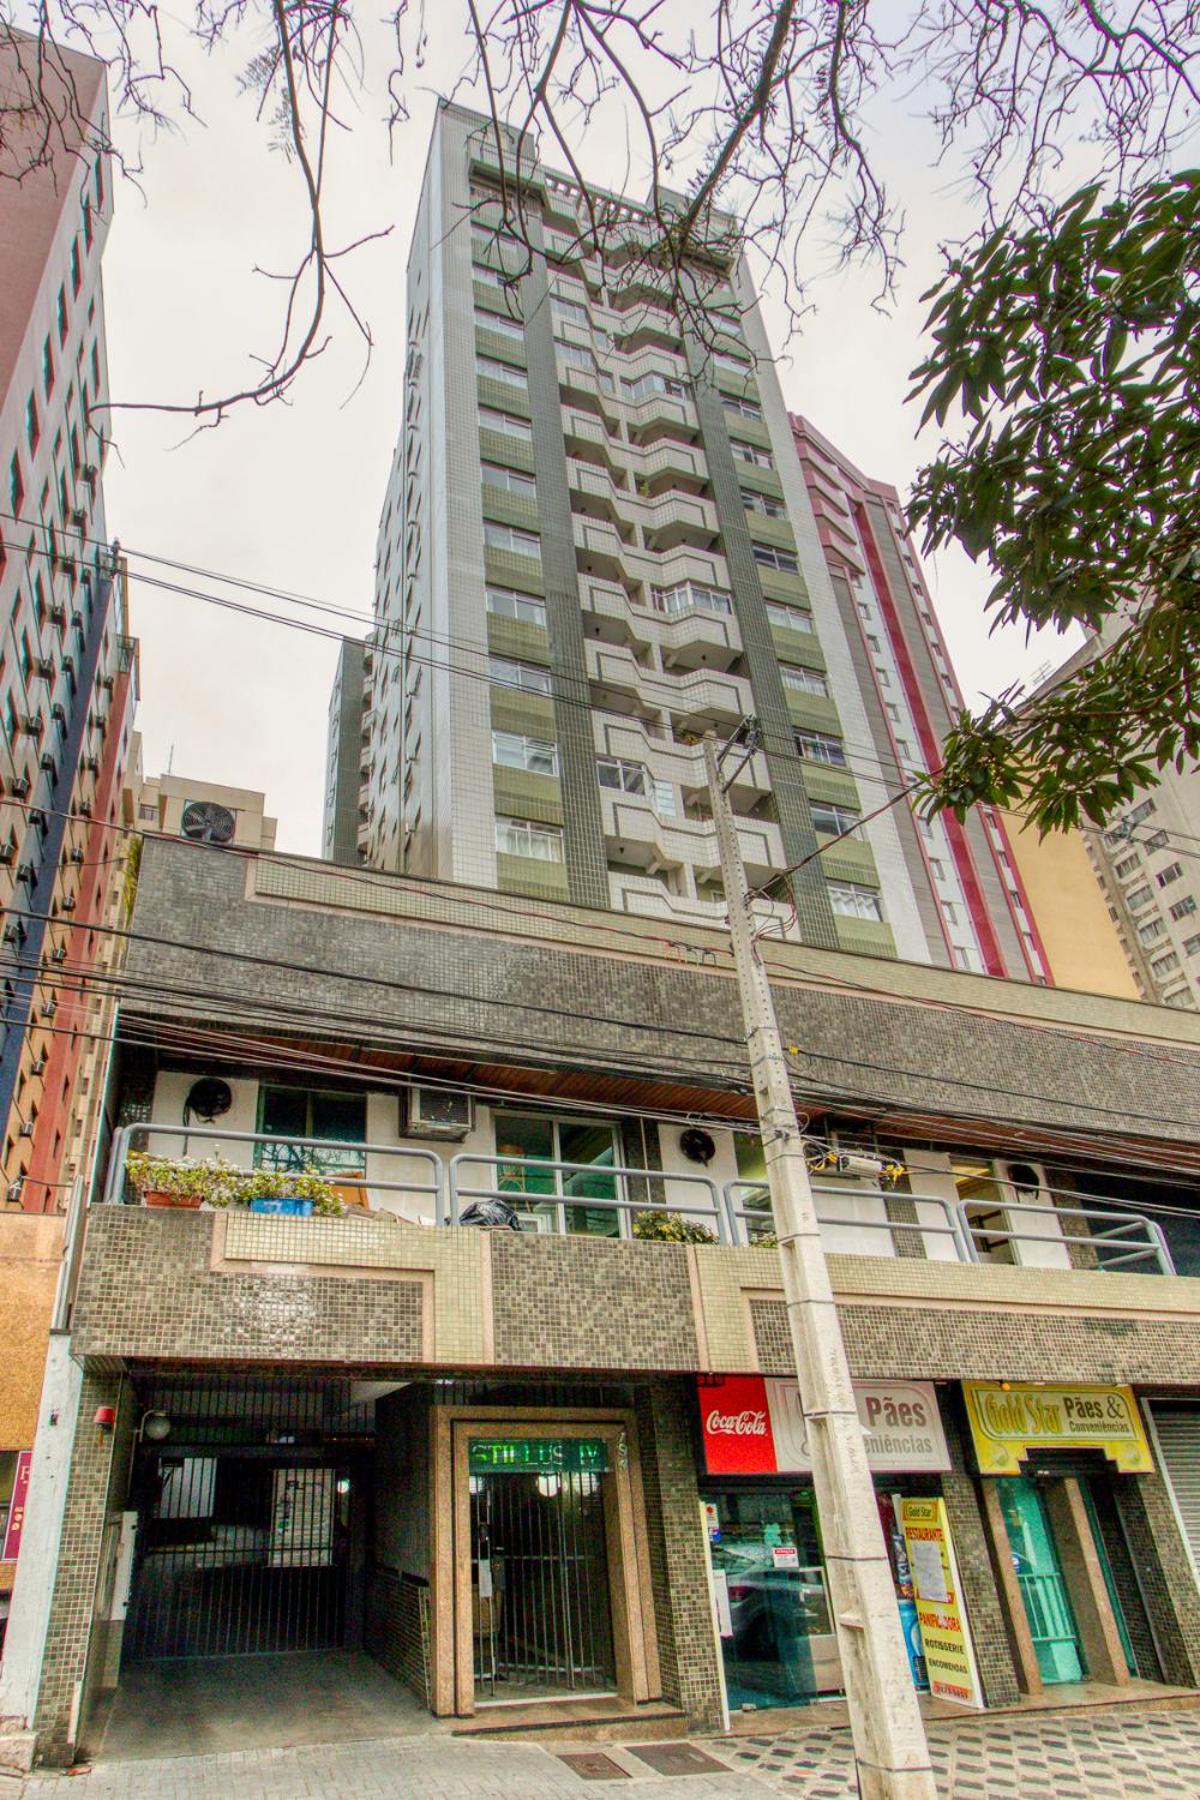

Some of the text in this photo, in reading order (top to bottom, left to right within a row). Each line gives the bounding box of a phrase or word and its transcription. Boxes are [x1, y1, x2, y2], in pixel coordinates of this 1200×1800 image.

[706, 1410, 766, 1436] Coca-Cola
[865, 1396, 927, 1427] Pães
[986, 1393, 1124, 1434] Gold Star Pães &
[863, 1434, 933, 1454] eniências
